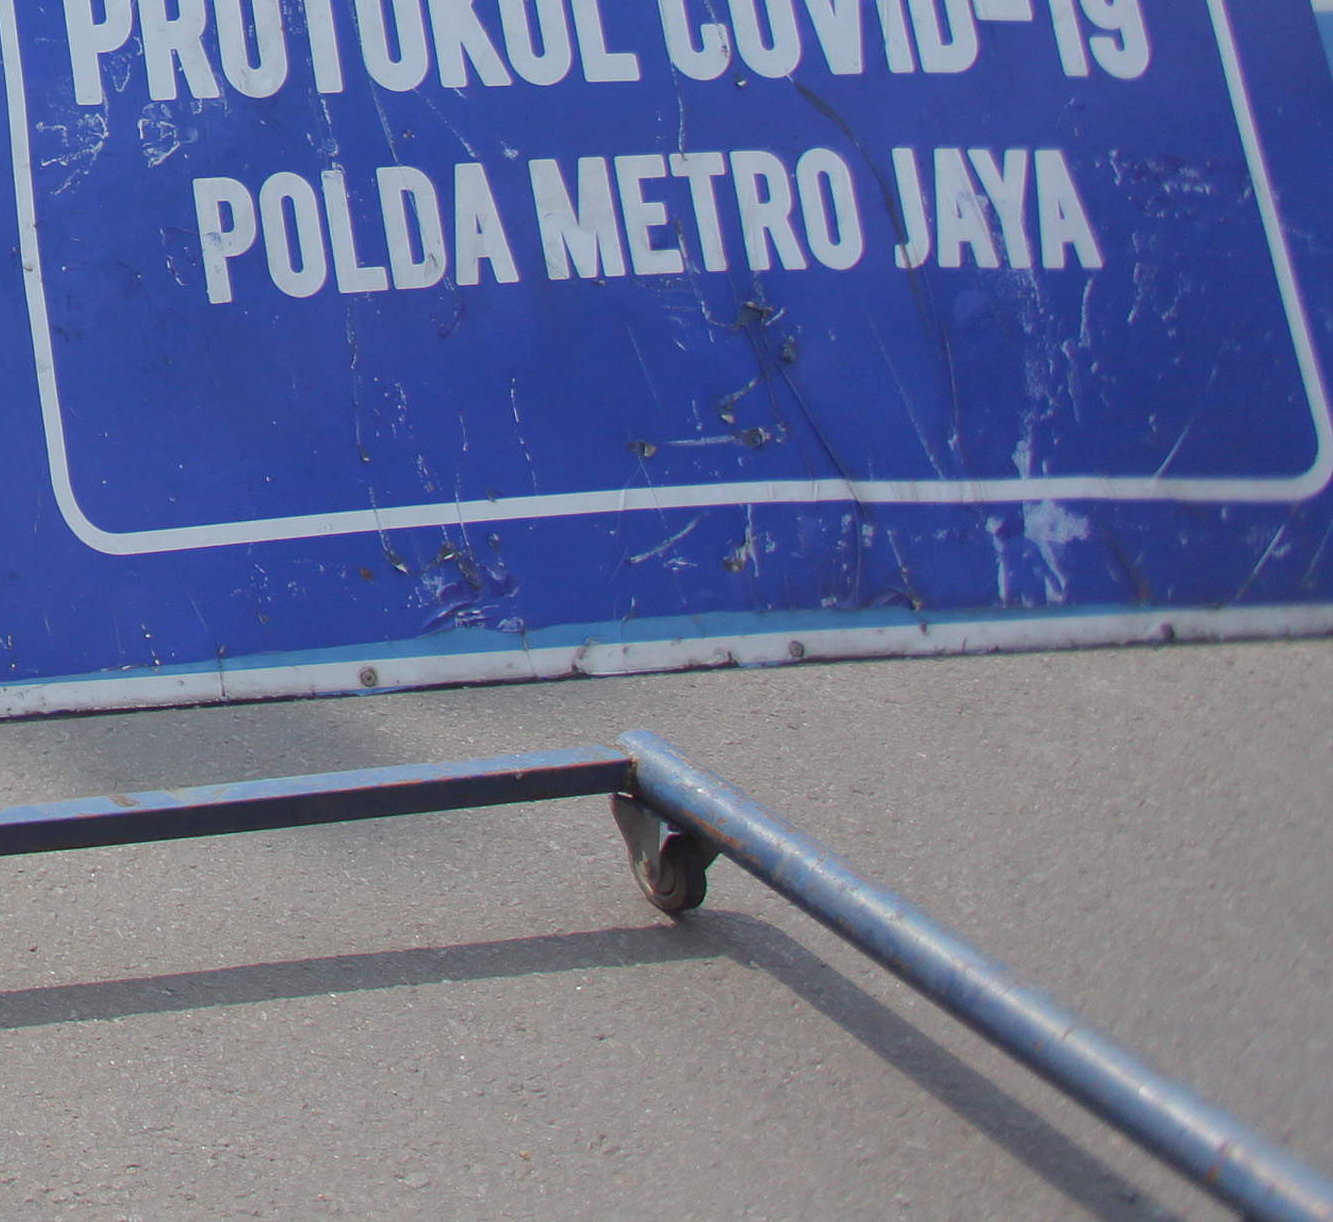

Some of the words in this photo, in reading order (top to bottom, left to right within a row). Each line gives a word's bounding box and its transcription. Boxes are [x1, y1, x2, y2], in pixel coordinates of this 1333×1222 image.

[191, 163, 519, 304] POLDA
[529, 148, 863, 280] METRO
[892, 148, 1103, 269] JAYA
